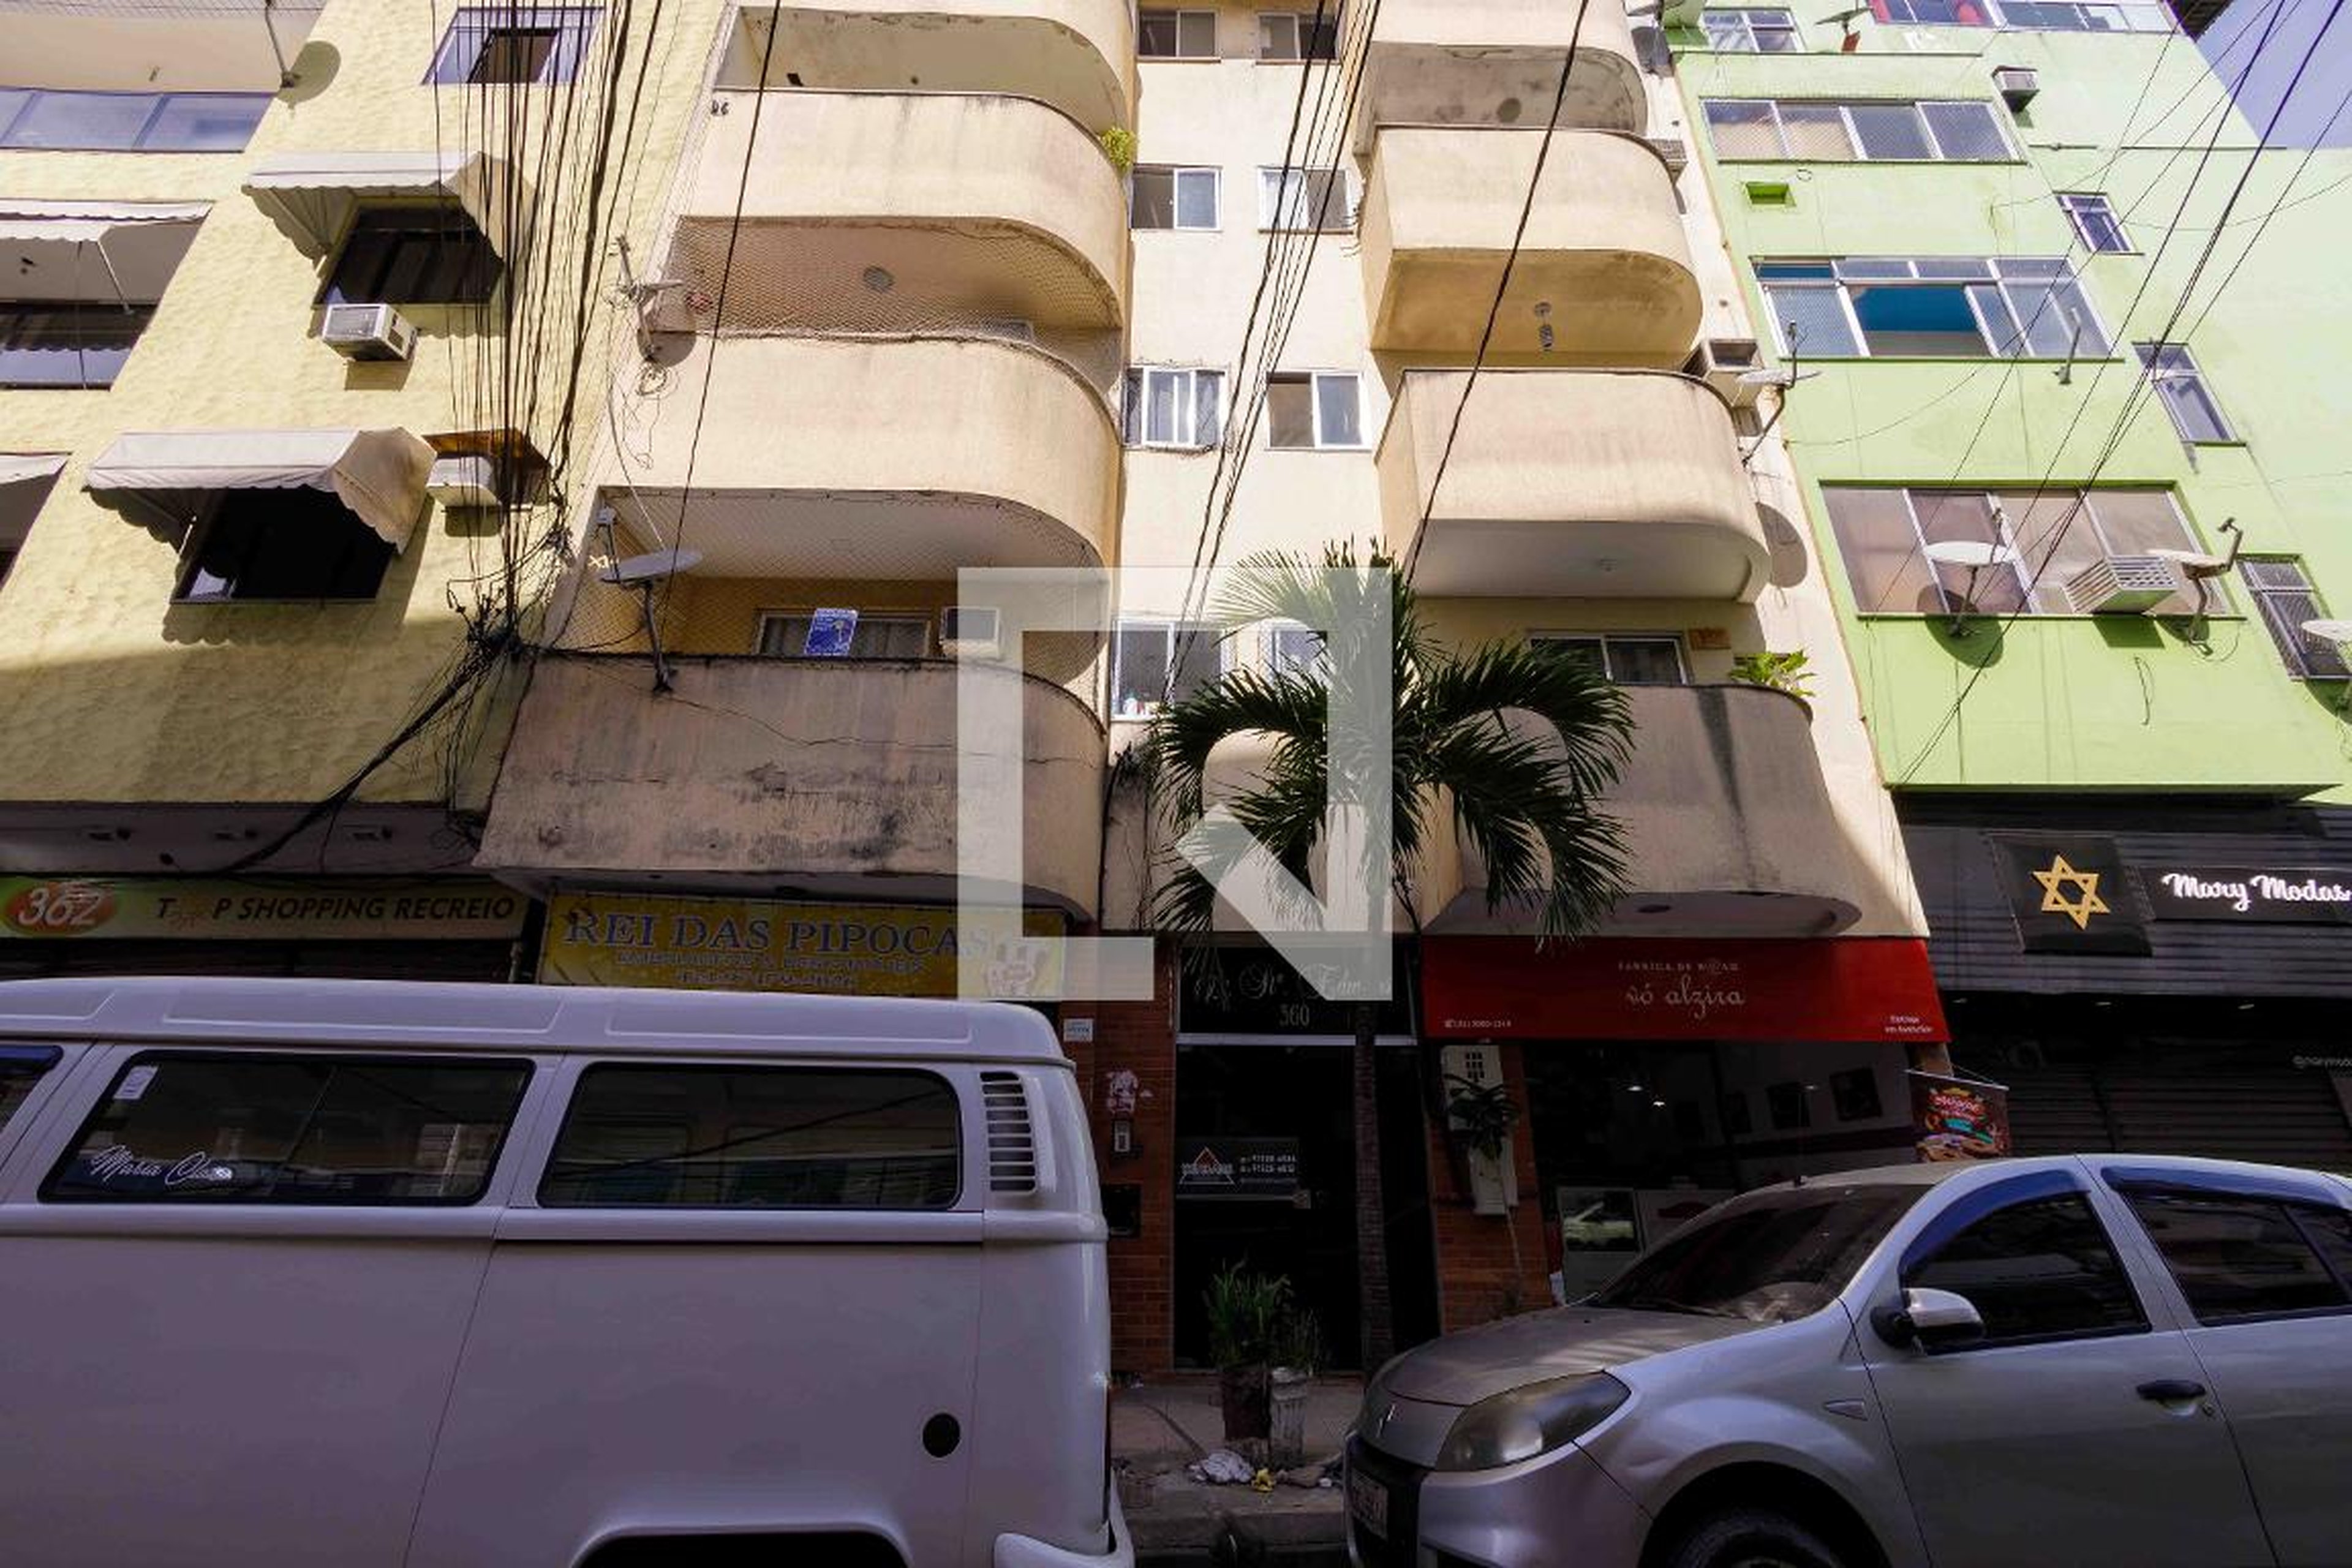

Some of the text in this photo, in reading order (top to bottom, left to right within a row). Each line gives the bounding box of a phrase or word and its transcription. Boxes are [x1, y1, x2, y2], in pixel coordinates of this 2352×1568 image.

[238, 897, 385, 919] SHOPPING
[393, 897, 515, 919] RECREIO
[2162, 873, 2252, 911] Mary
[562, 911, 660, 948] REI
[671, 914, 771, 951] DAS
[1664, 973, 1746, 1020] alzira
